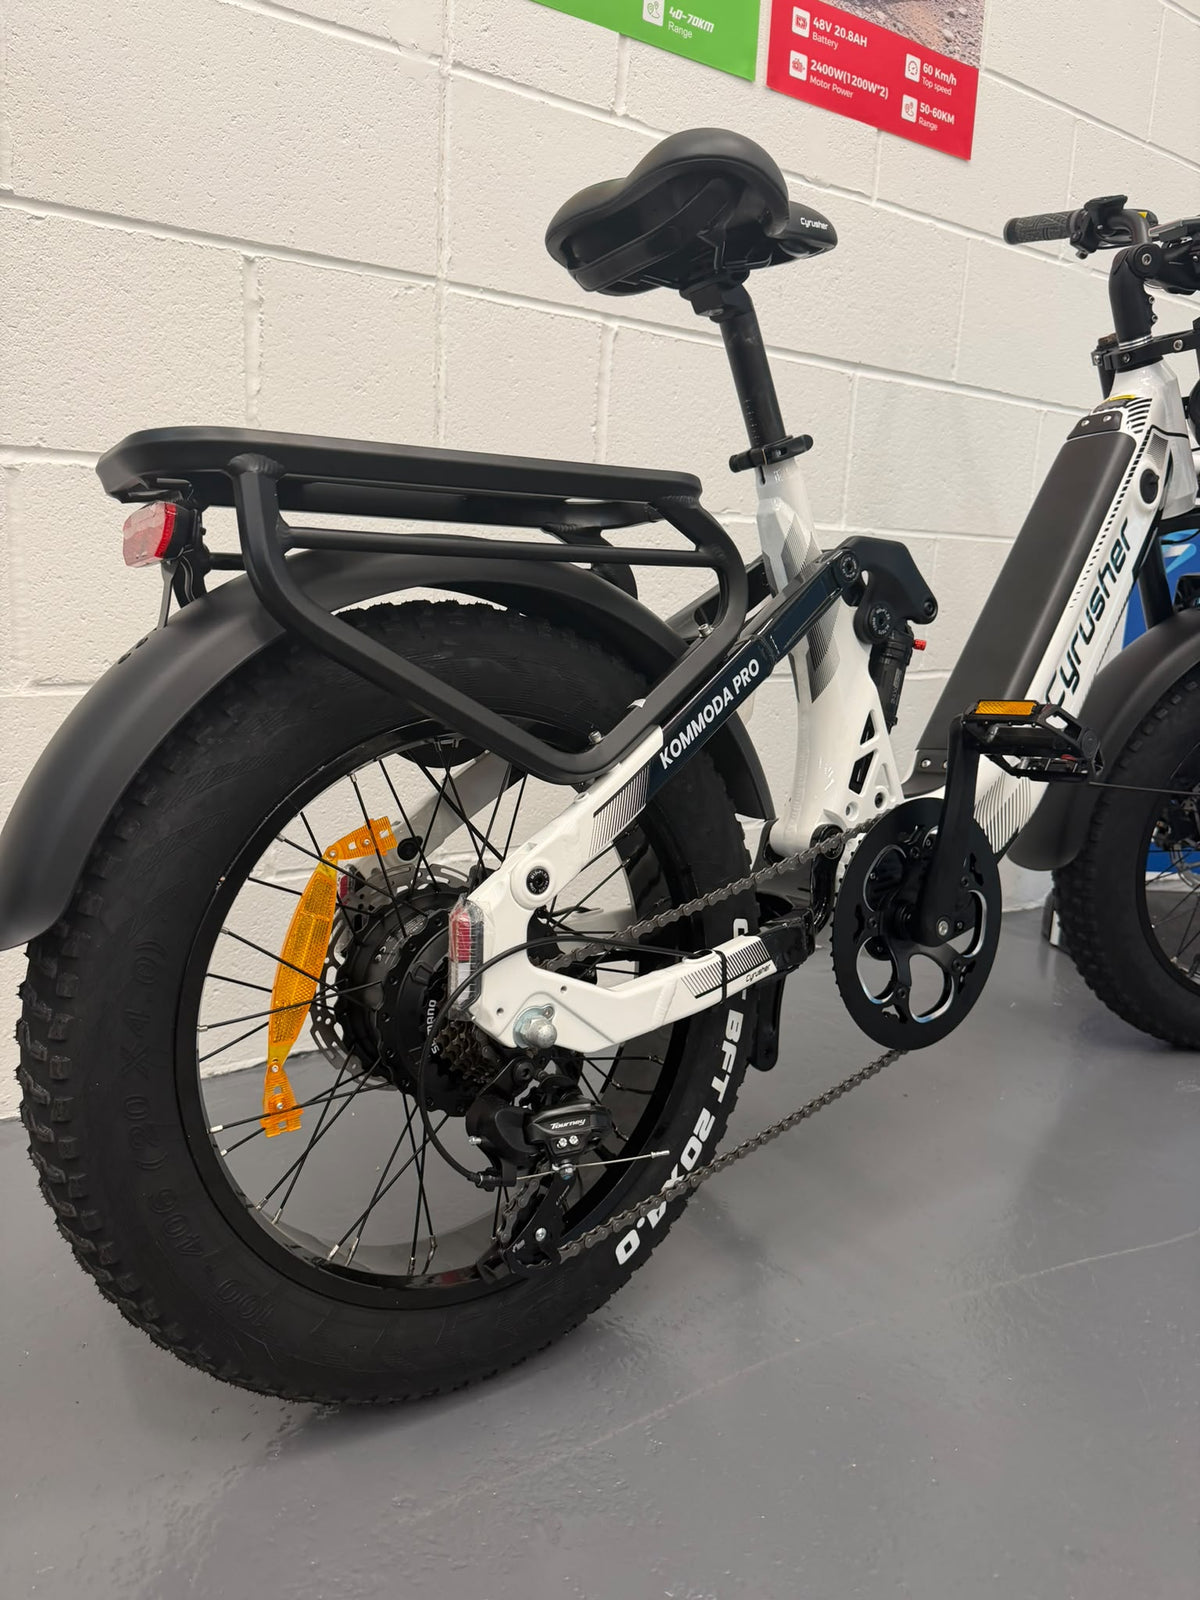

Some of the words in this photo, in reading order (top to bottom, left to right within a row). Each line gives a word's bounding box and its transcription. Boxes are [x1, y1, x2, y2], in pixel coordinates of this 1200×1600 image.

[668, 21, 693, 39] Range
[812, 31, 839, 50] Battery
[813, 17, 832, 33] 48V
[834, 25, 868, 48] 20.8AH
[921, 76, 933, 89] Top
[934, 83, 952, 96] speed
[922, 63, 933, 76] 60
[934, 68, 957, 86] Km/h
[809, 75, 831, 90] Motor
[832, 83, 854, 98] Power
[918, 117, 938, 132] Range
[920, 102, 955, 125] 50-60KM
[800, 217, 828, 230] Cyrusher
[660, 686, 734, 769] KOMMODA
[732, 659, 759, 694] PRO
[426, 1000, 440, 1055] SMANO
[711, 1009, 744, 1104] BFT
[550, 1118, 586, 1130] Tourney
[615, 1107, 715, 1265] 20X4.0
